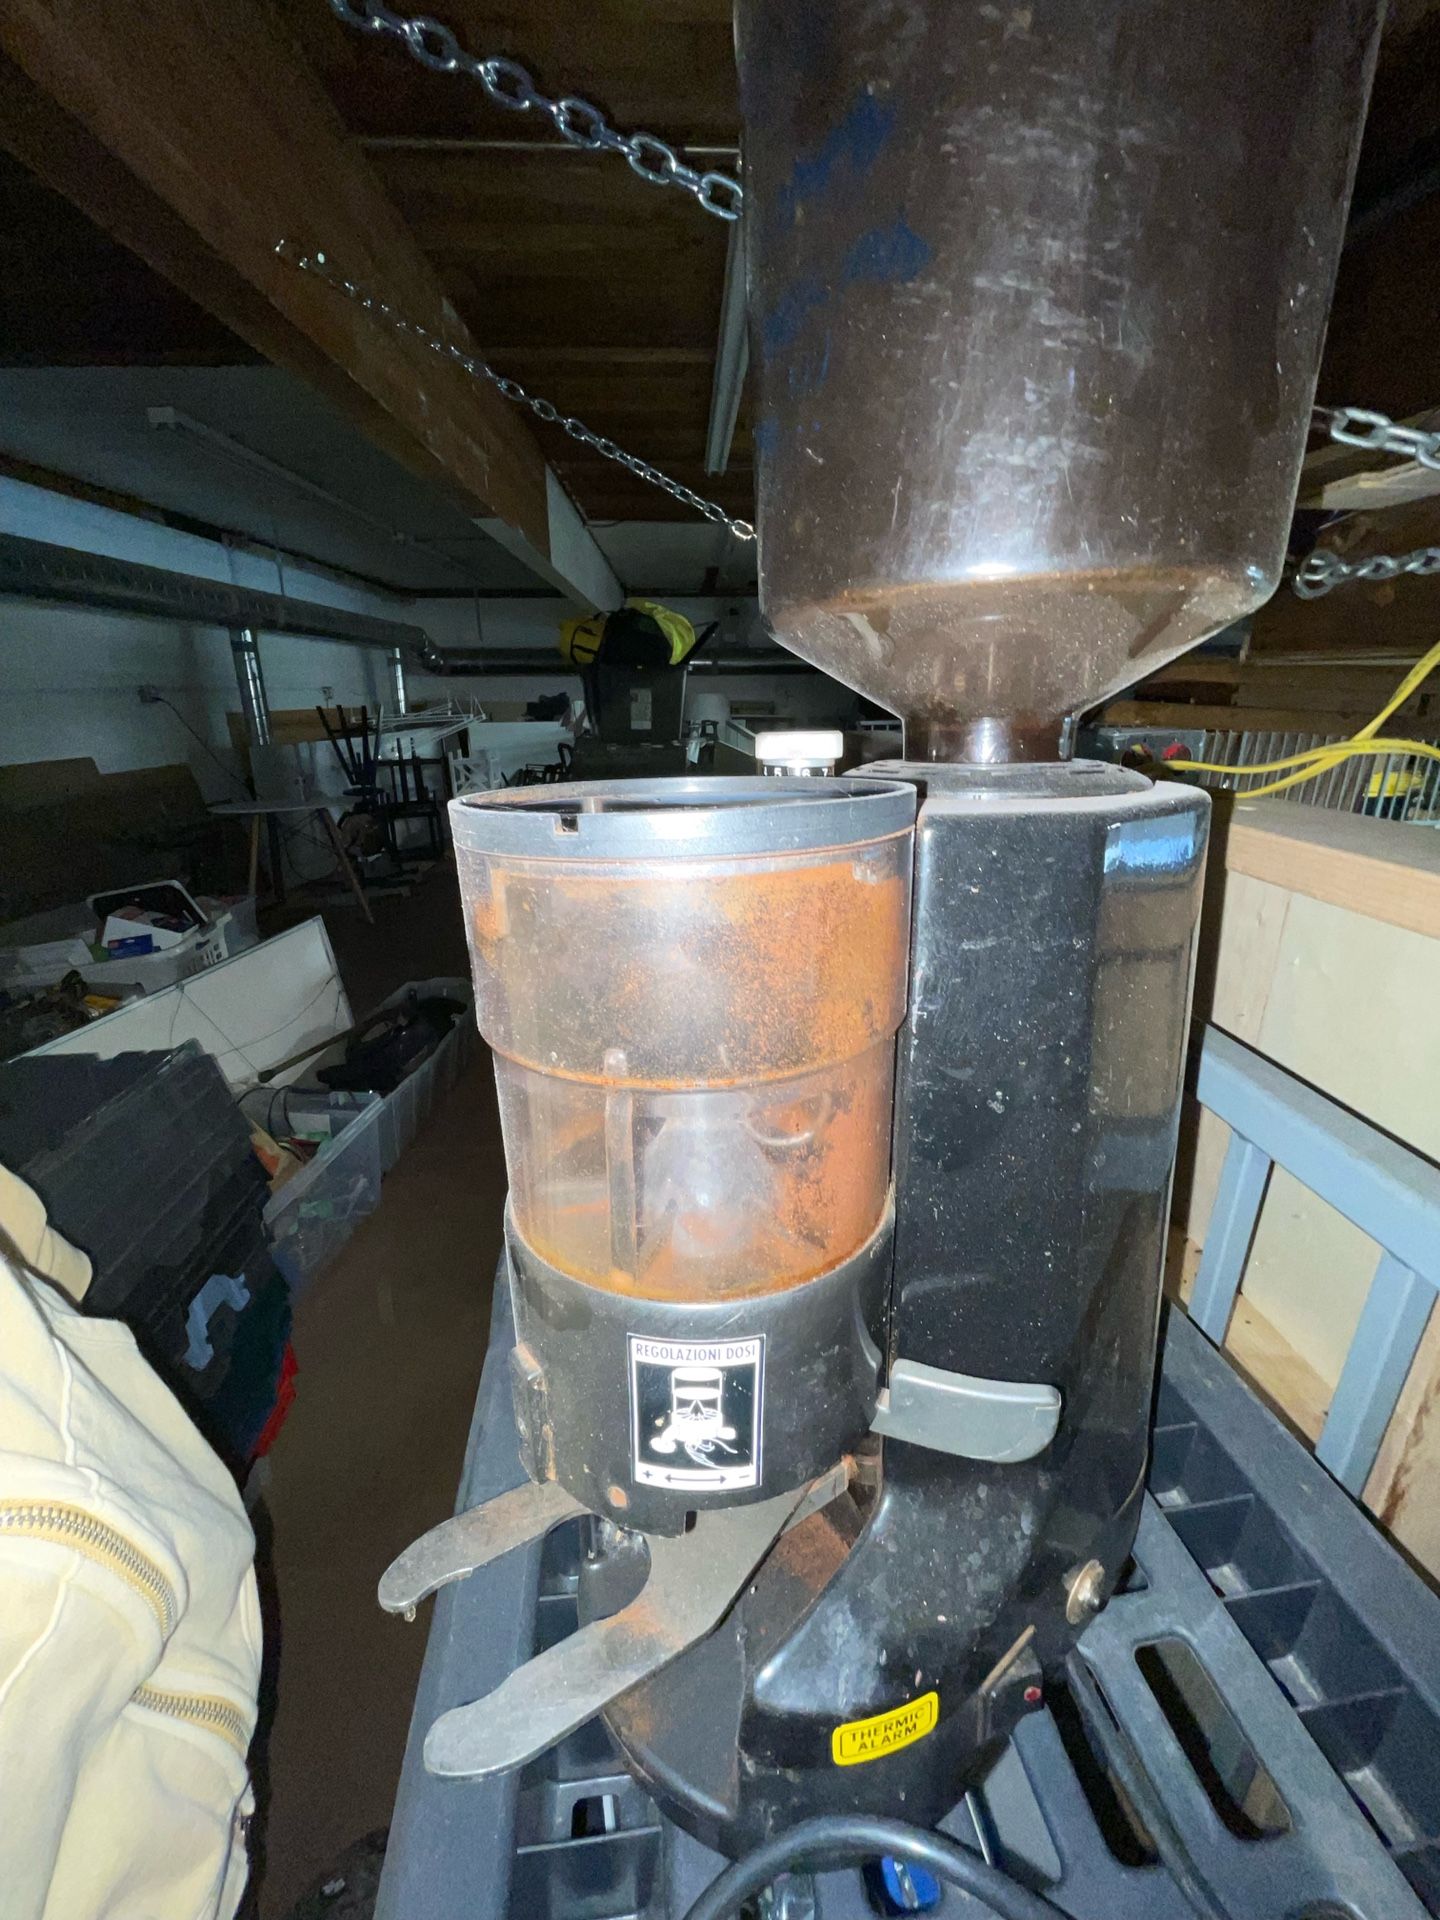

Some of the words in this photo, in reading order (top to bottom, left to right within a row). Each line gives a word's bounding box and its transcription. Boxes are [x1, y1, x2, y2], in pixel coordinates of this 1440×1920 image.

[635, 1343, 721, 1361] REGOLAZIONI
[726, 1344, 756, 1360] DOSI
[851, 1707, 925, 1742] THERMIC
[857, 1723, 918, 1753] ALARM
